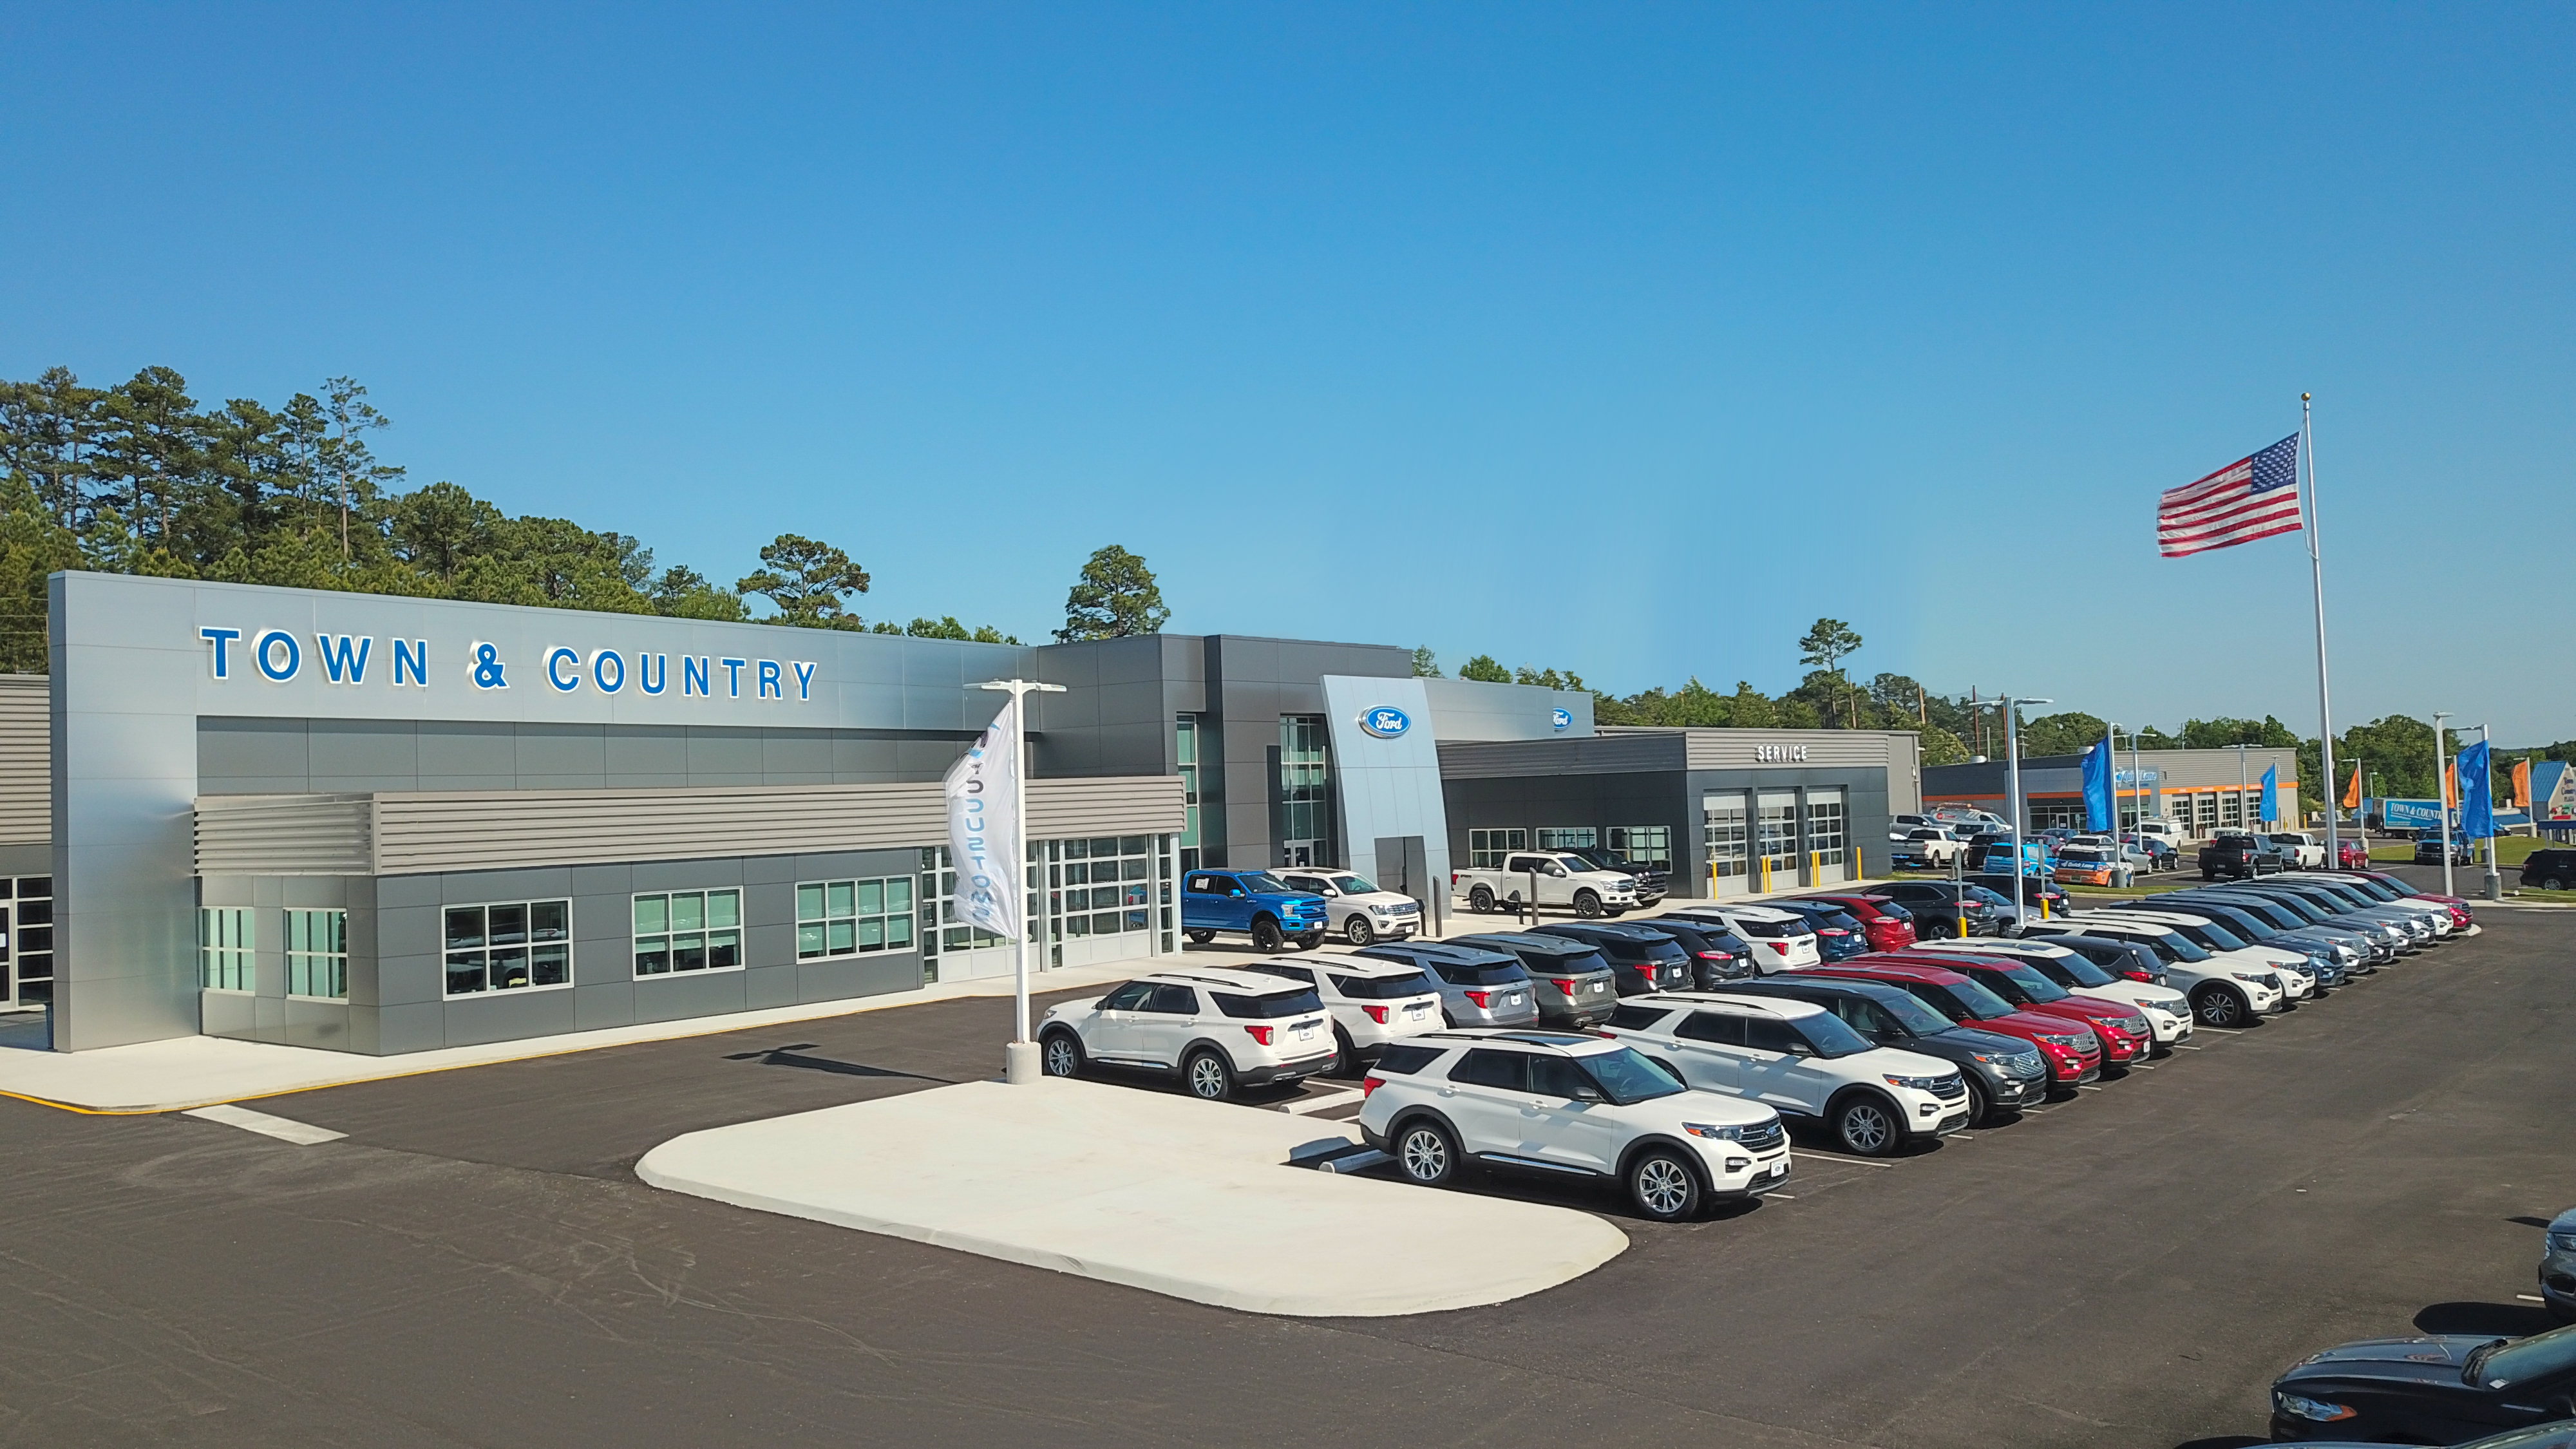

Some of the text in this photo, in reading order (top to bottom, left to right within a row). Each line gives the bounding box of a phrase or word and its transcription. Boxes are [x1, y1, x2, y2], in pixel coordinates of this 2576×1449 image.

[199, 626, 817, 701] TOWN & COUNTRY
[1376, 712, 1403, 730] Ford
[1553, 711, 1569, 725] Ford
[1757, 745, 1807, 760] SERVICE
[2391, 802, 2443, 820] TOWN & COUNTR
